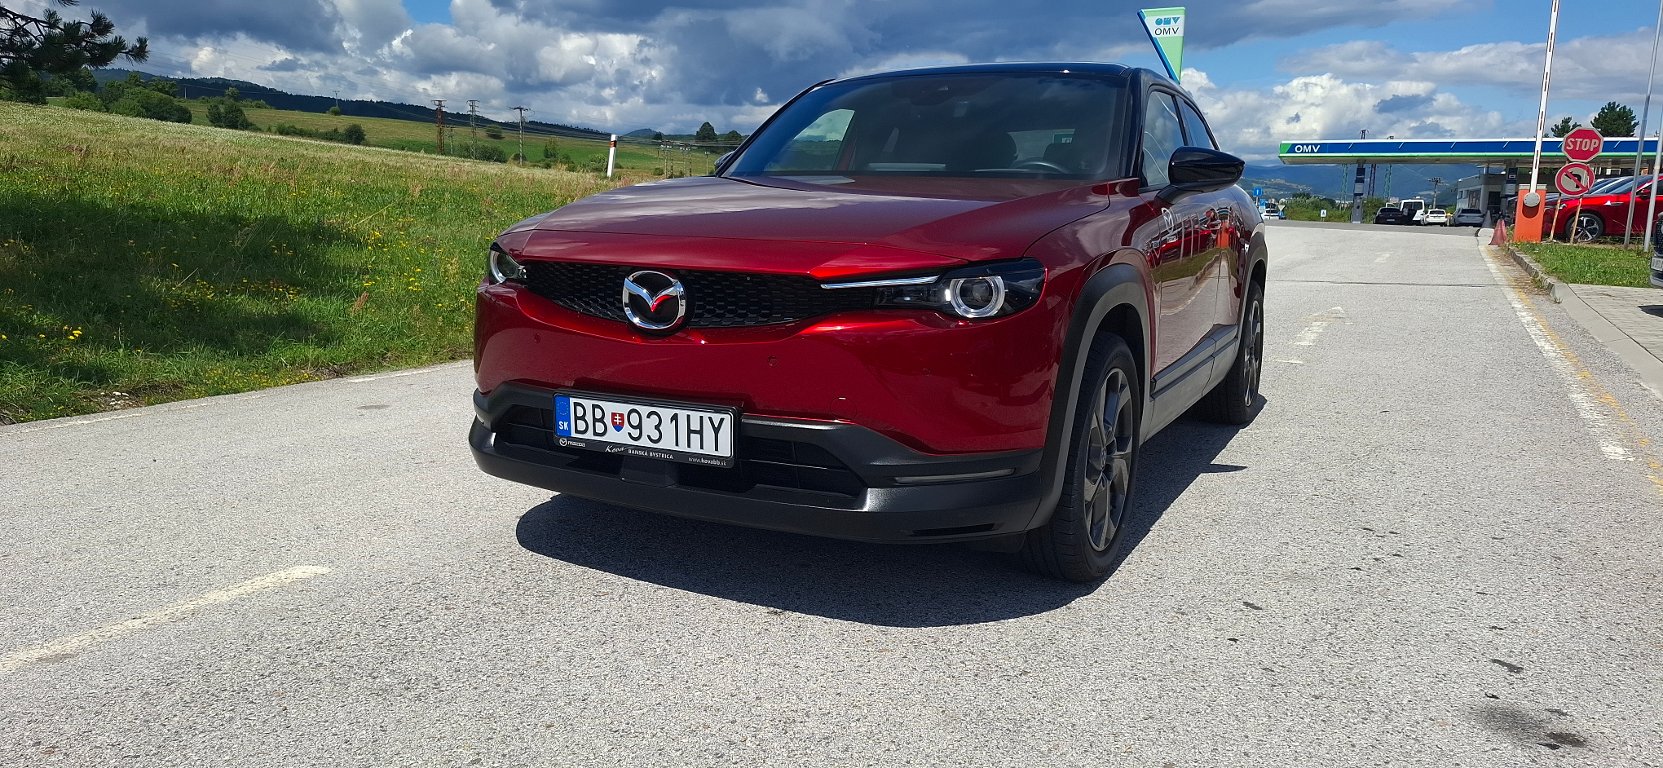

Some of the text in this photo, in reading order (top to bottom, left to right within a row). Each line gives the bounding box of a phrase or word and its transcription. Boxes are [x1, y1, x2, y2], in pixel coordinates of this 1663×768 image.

[1154, 26, 1179, 36] OMV
[1295, 144, 1321, 153] OMV
[1566, 137, 1599, 152] STOP
[558, 420, 569, 431] SK
[573, 401, 725, 452] BB 931HY
